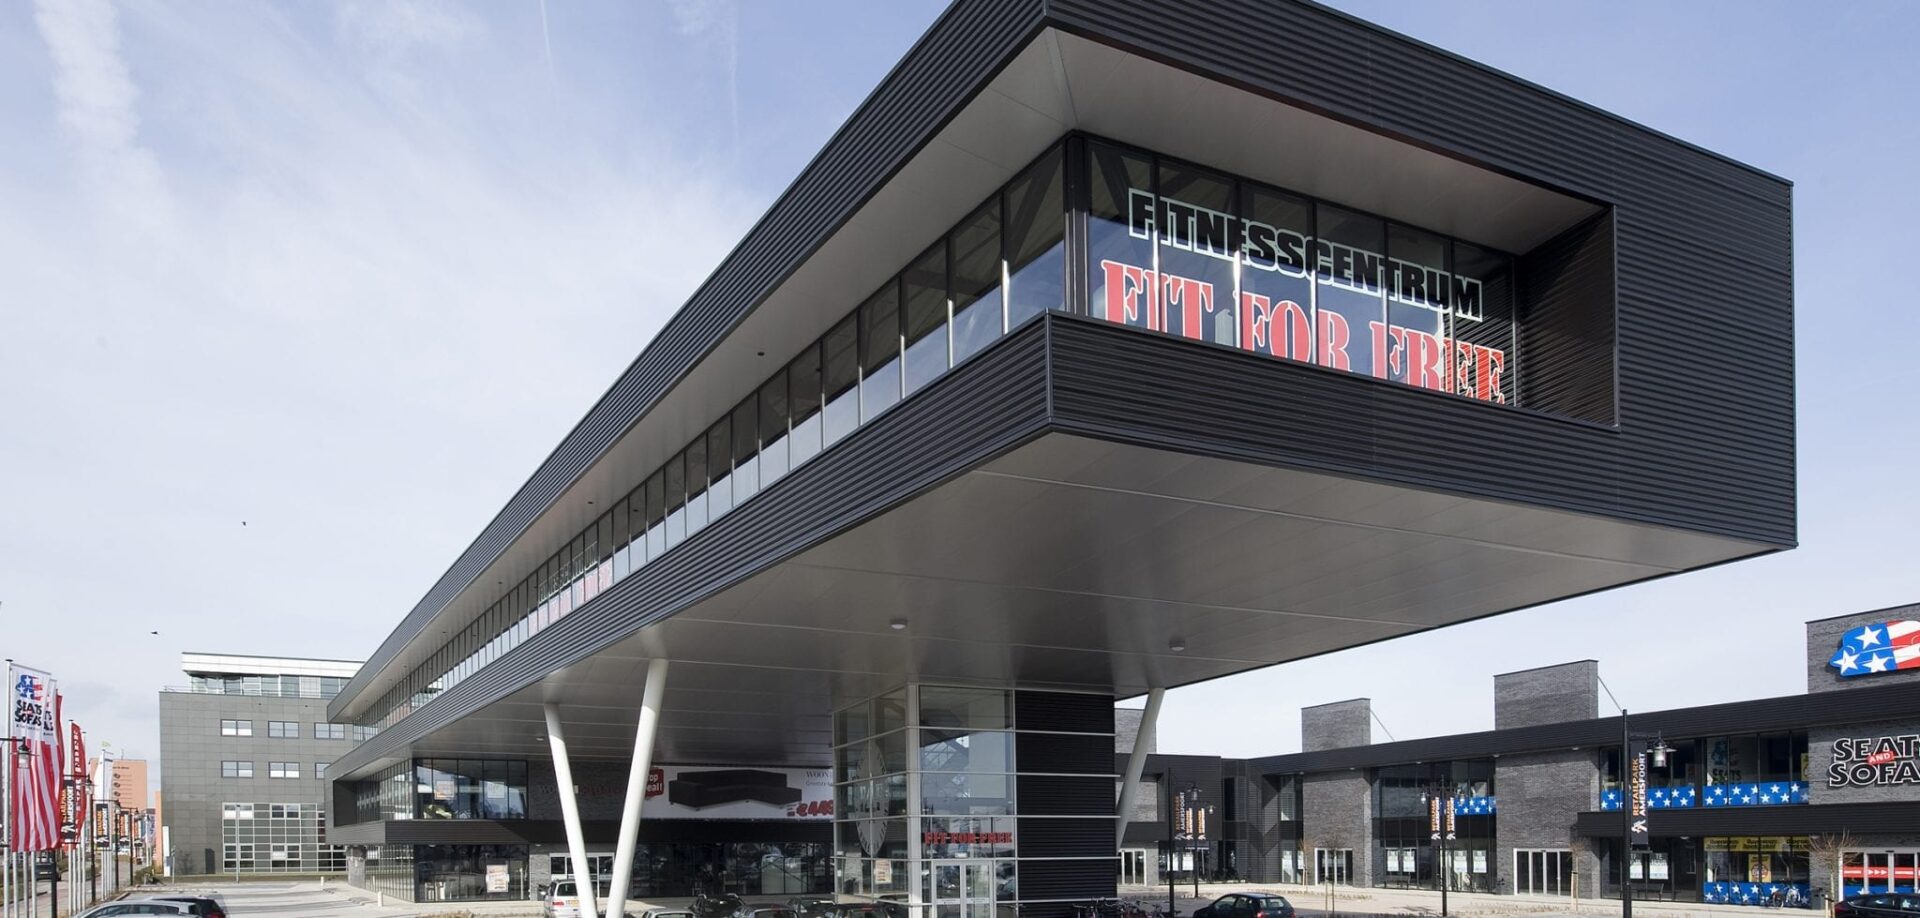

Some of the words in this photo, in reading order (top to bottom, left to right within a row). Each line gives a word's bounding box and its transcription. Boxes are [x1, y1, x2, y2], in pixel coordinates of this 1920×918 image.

[1128, 187, 1482, 323] FITNESSCENTRUM
[1101, 259, 1213, 341] FIT
[1235, 289, 1352, 372] FOR
[1369, 321, 1505, 405] FREE
[1833, 734, 1920, 763] SEAT
[1869, 752, 1892, 764] AND
[647, 782, 663, 792] eal!
[1638, 752, 1646, 817] AMERSFOORT
